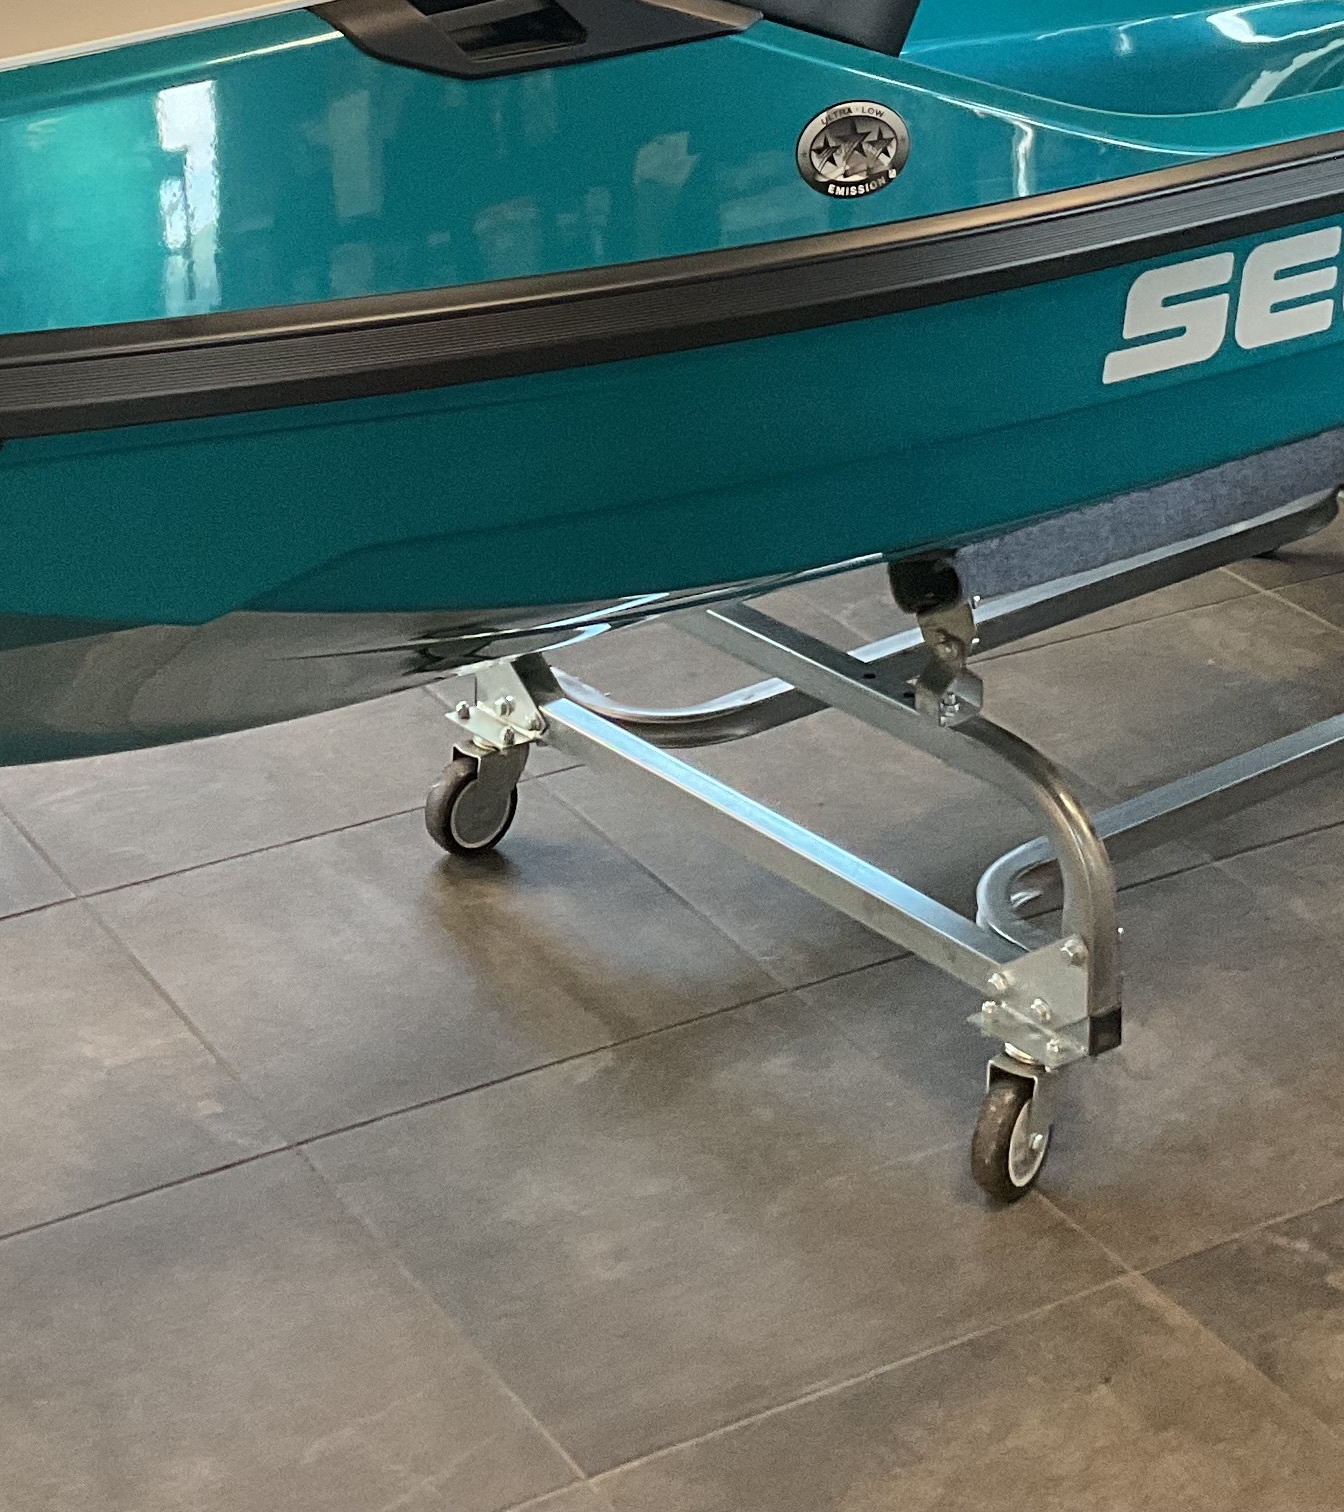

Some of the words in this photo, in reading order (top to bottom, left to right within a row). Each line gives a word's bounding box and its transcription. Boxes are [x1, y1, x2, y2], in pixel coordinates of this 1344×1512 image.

[821, 107, 852, 125] ULTRA
[862, 107, 884, 118] LOW
[827, 176, 887, 196] EMISSION
